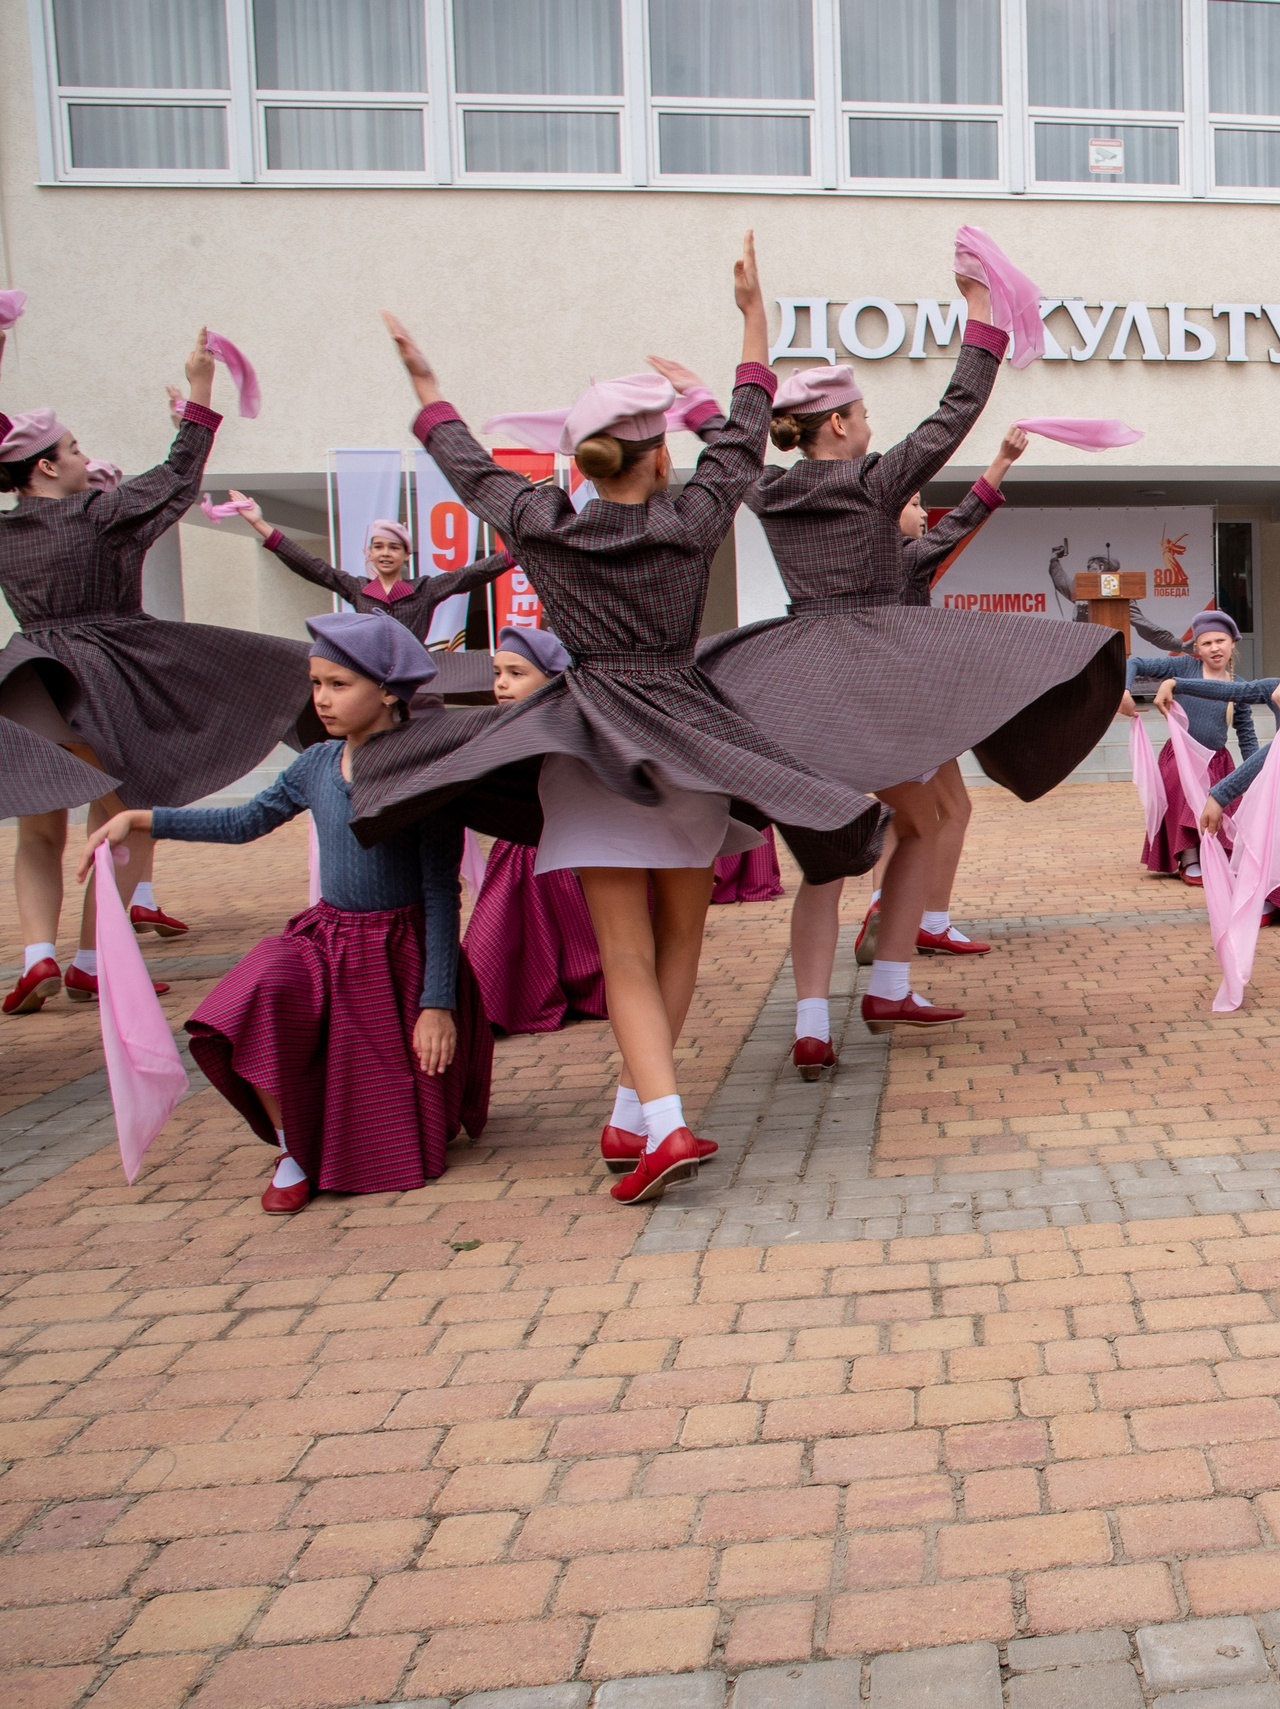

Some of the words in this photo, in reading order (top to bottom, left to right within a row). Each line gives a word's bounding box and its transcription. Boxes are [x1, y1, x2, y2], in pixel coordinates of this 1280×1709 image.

[769, 297, 969, 365] ДОМ
[430, 502, 468, 572] 9
[1154, 568, 1173, 585] 80
[1154, 587, 1190, 598] ПОБЕДА!
[943, 593, 1046, 613] ГОРДИМСЯ
